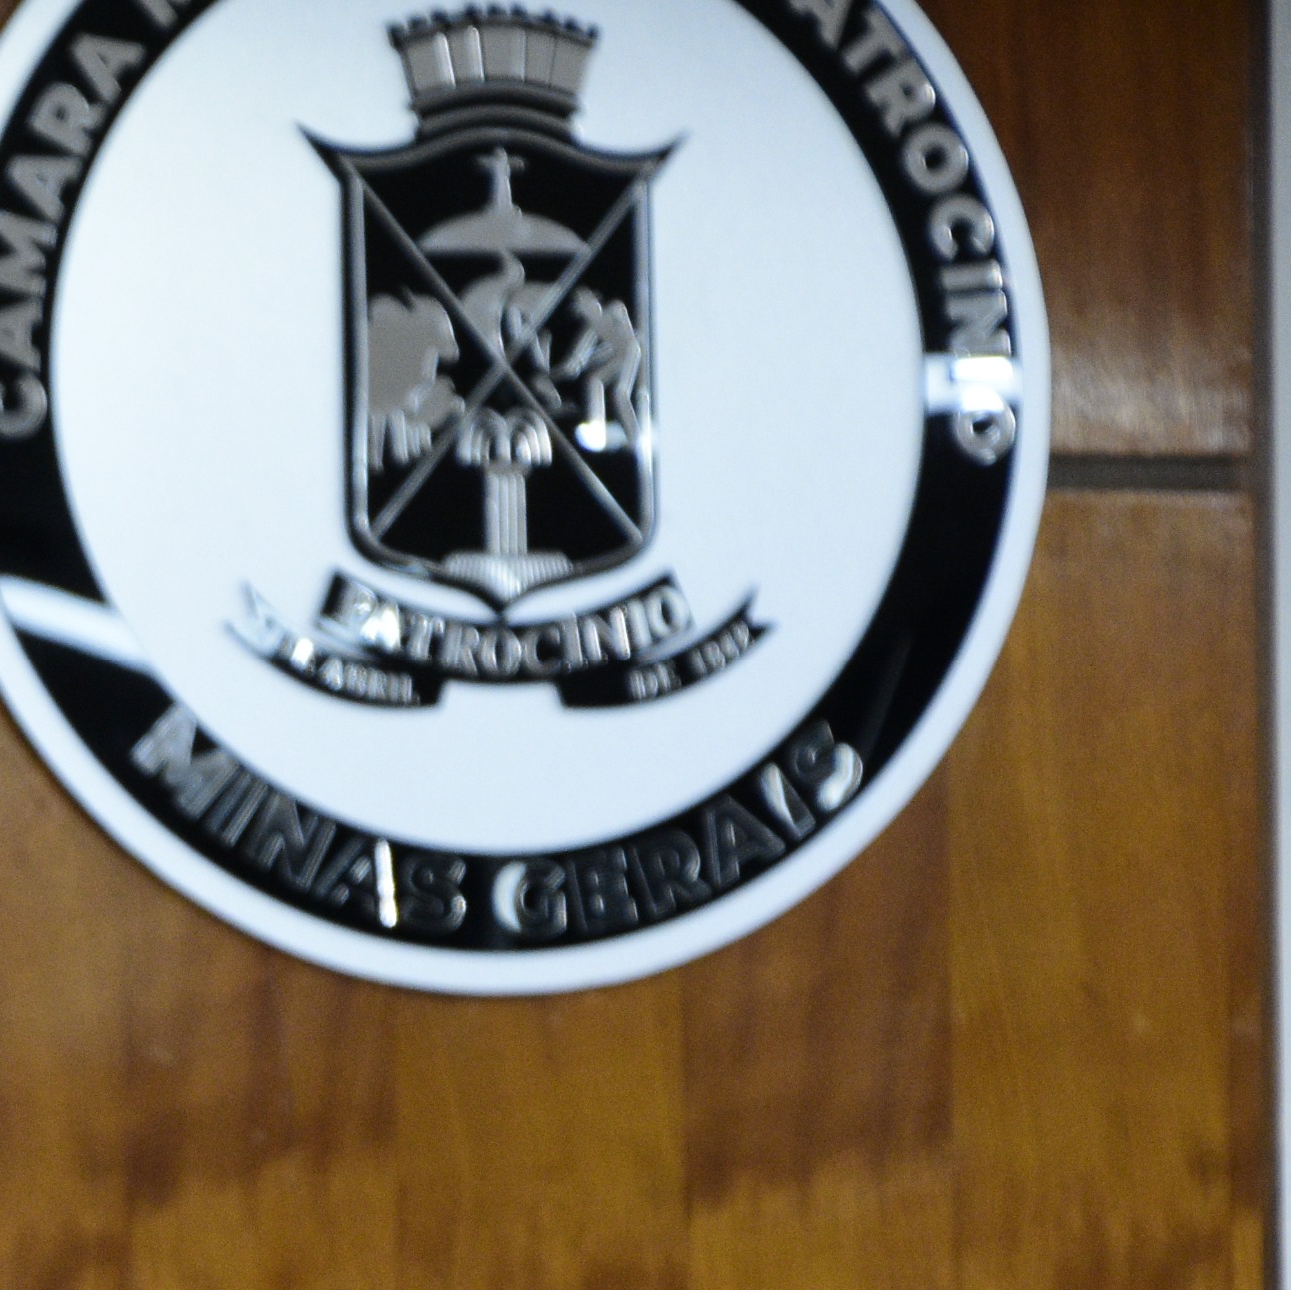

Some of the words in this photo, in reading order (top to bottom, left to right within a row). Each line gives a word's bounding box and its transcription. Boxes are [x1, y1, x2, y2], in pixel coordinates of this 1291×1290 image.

[335, 574, 694, 678] PATROCINIO
[130, 702, 466, 931] MINAS
[492, 719, 864, 935] GERAIS
